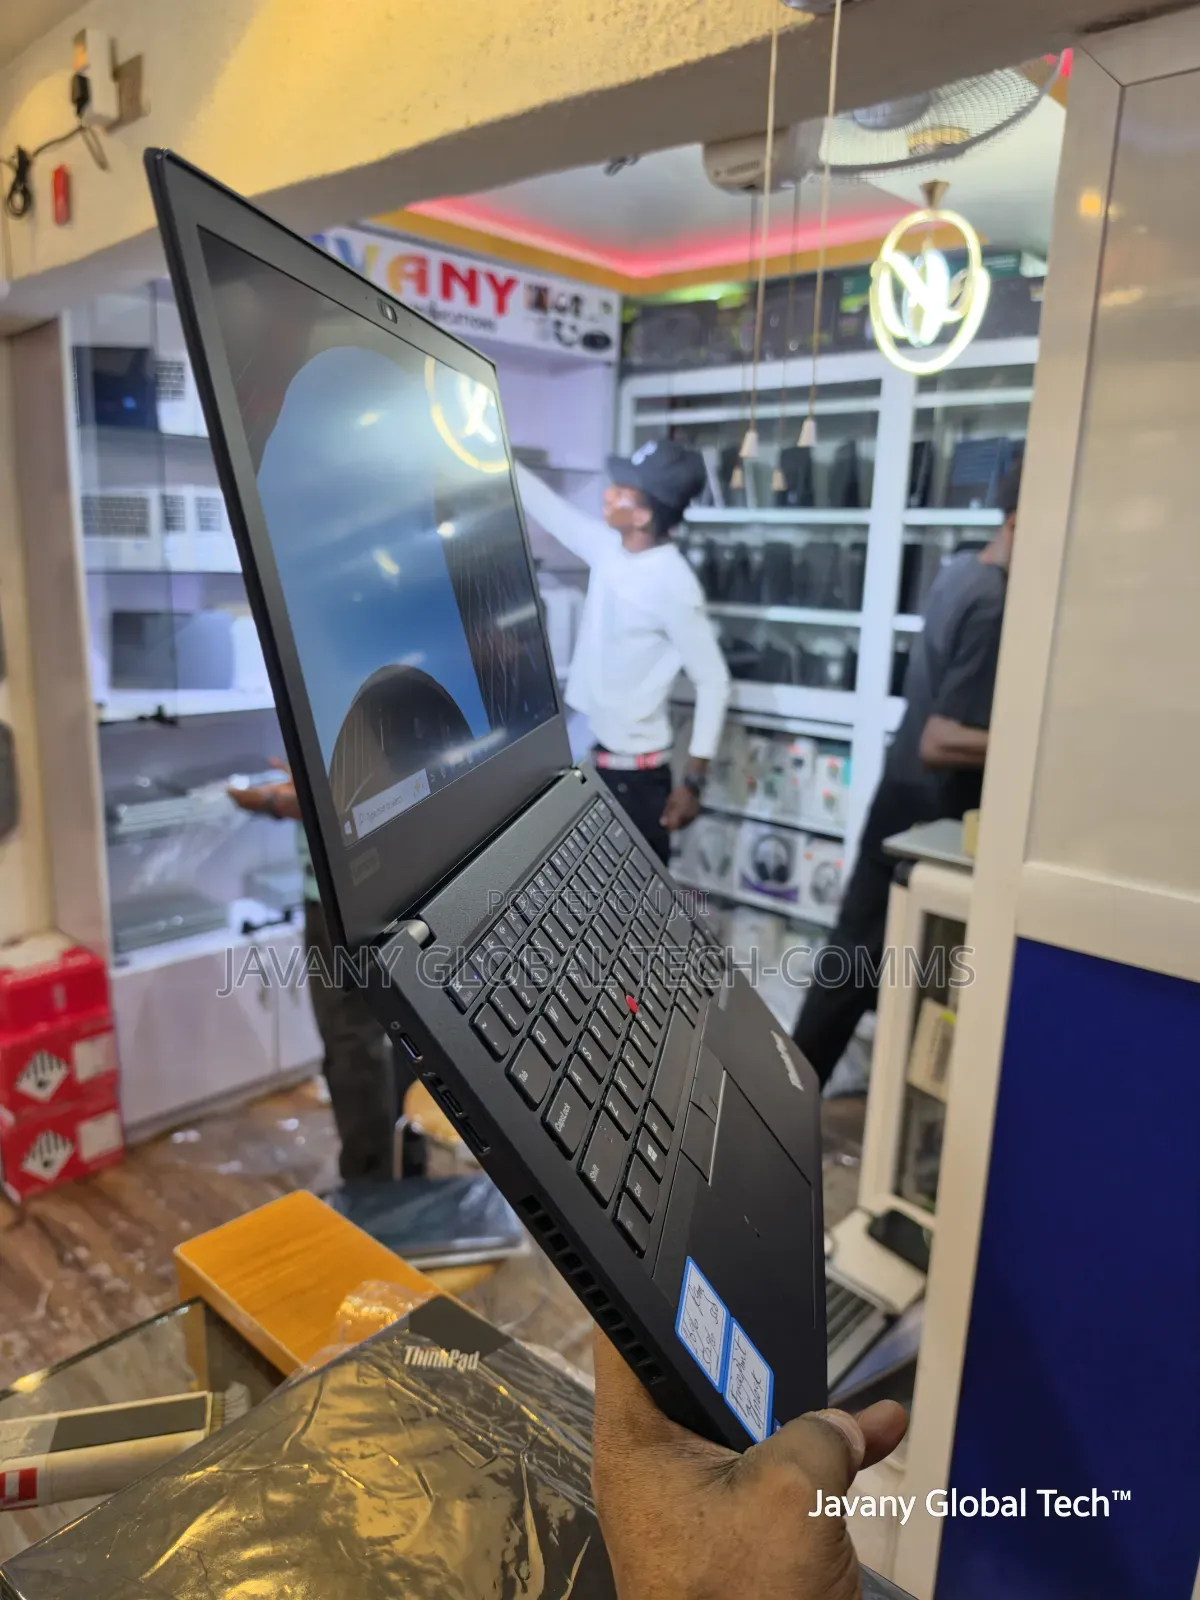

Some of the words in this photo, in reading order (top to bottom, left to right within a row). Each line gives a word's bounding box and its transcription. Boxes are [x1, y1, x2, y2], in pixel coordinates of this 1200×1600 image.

[560, 990, 568, 1002] E
[549, 1006, 558, 1022] W
[601, 1006, 608, 1018] F
[536, 1031, 546, 1044] Q
[592, 1026, 600, 1038] D
[633, 1034, 641, 1046] V
[583, 1047, 591, 1060] S
[626, 1055, 634, 1068] C
[519, 1070, 528, 1082] Tab
[572, 1071, 582, 1084] A
[618, 1077, 627, 1091] X
[609, 1102, 618, 1116] Z
[555, 1103, 570, 1132] CapsLock
[590, 1164, 599, 1182] Shift
[403, 1345, 480, 1373] ThinkPad
